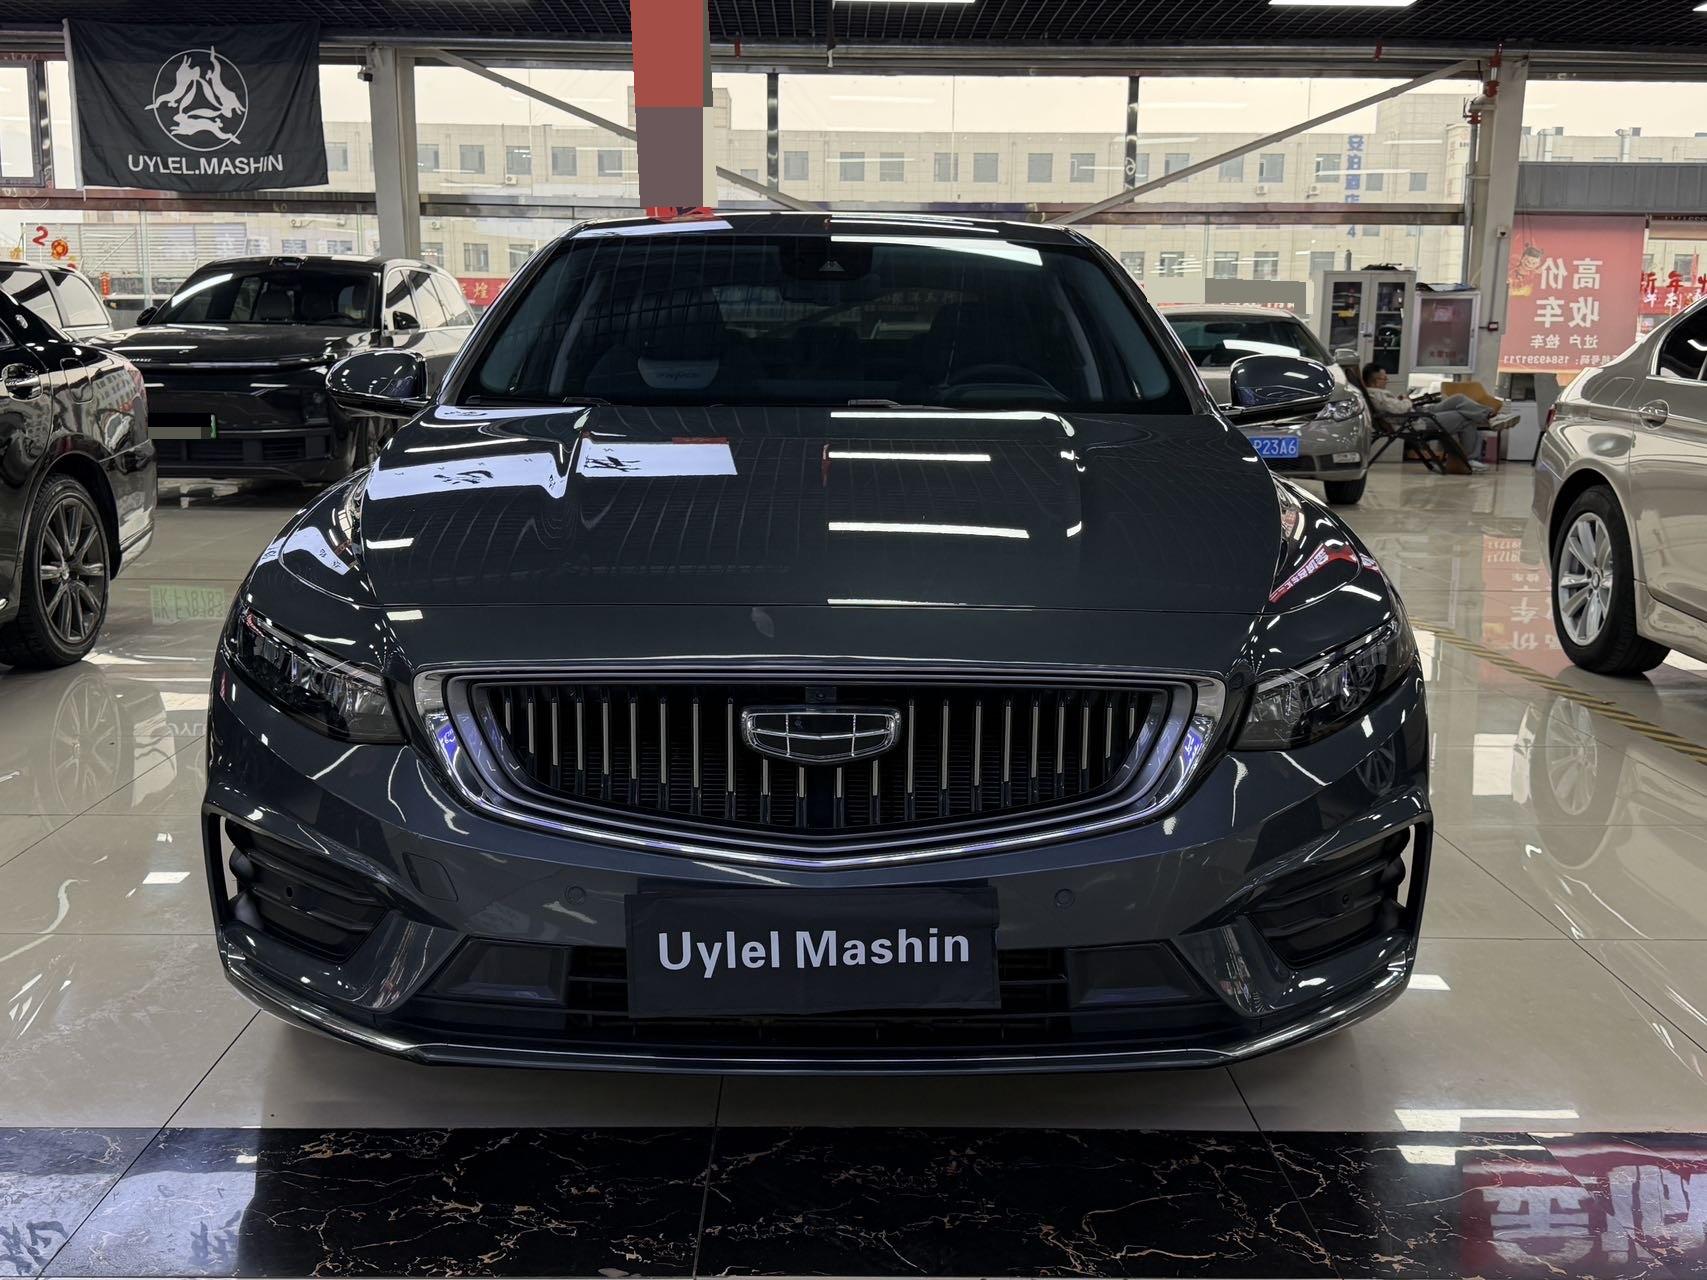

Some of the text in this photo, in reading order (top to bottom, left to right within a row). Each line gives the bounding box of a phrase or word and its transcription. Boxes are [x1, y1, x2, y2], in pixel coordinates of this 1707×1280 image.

[128, 154, 284, 175] UYLEL.MASHIN
[658, 927, 970, 979] Uylel Mashin
